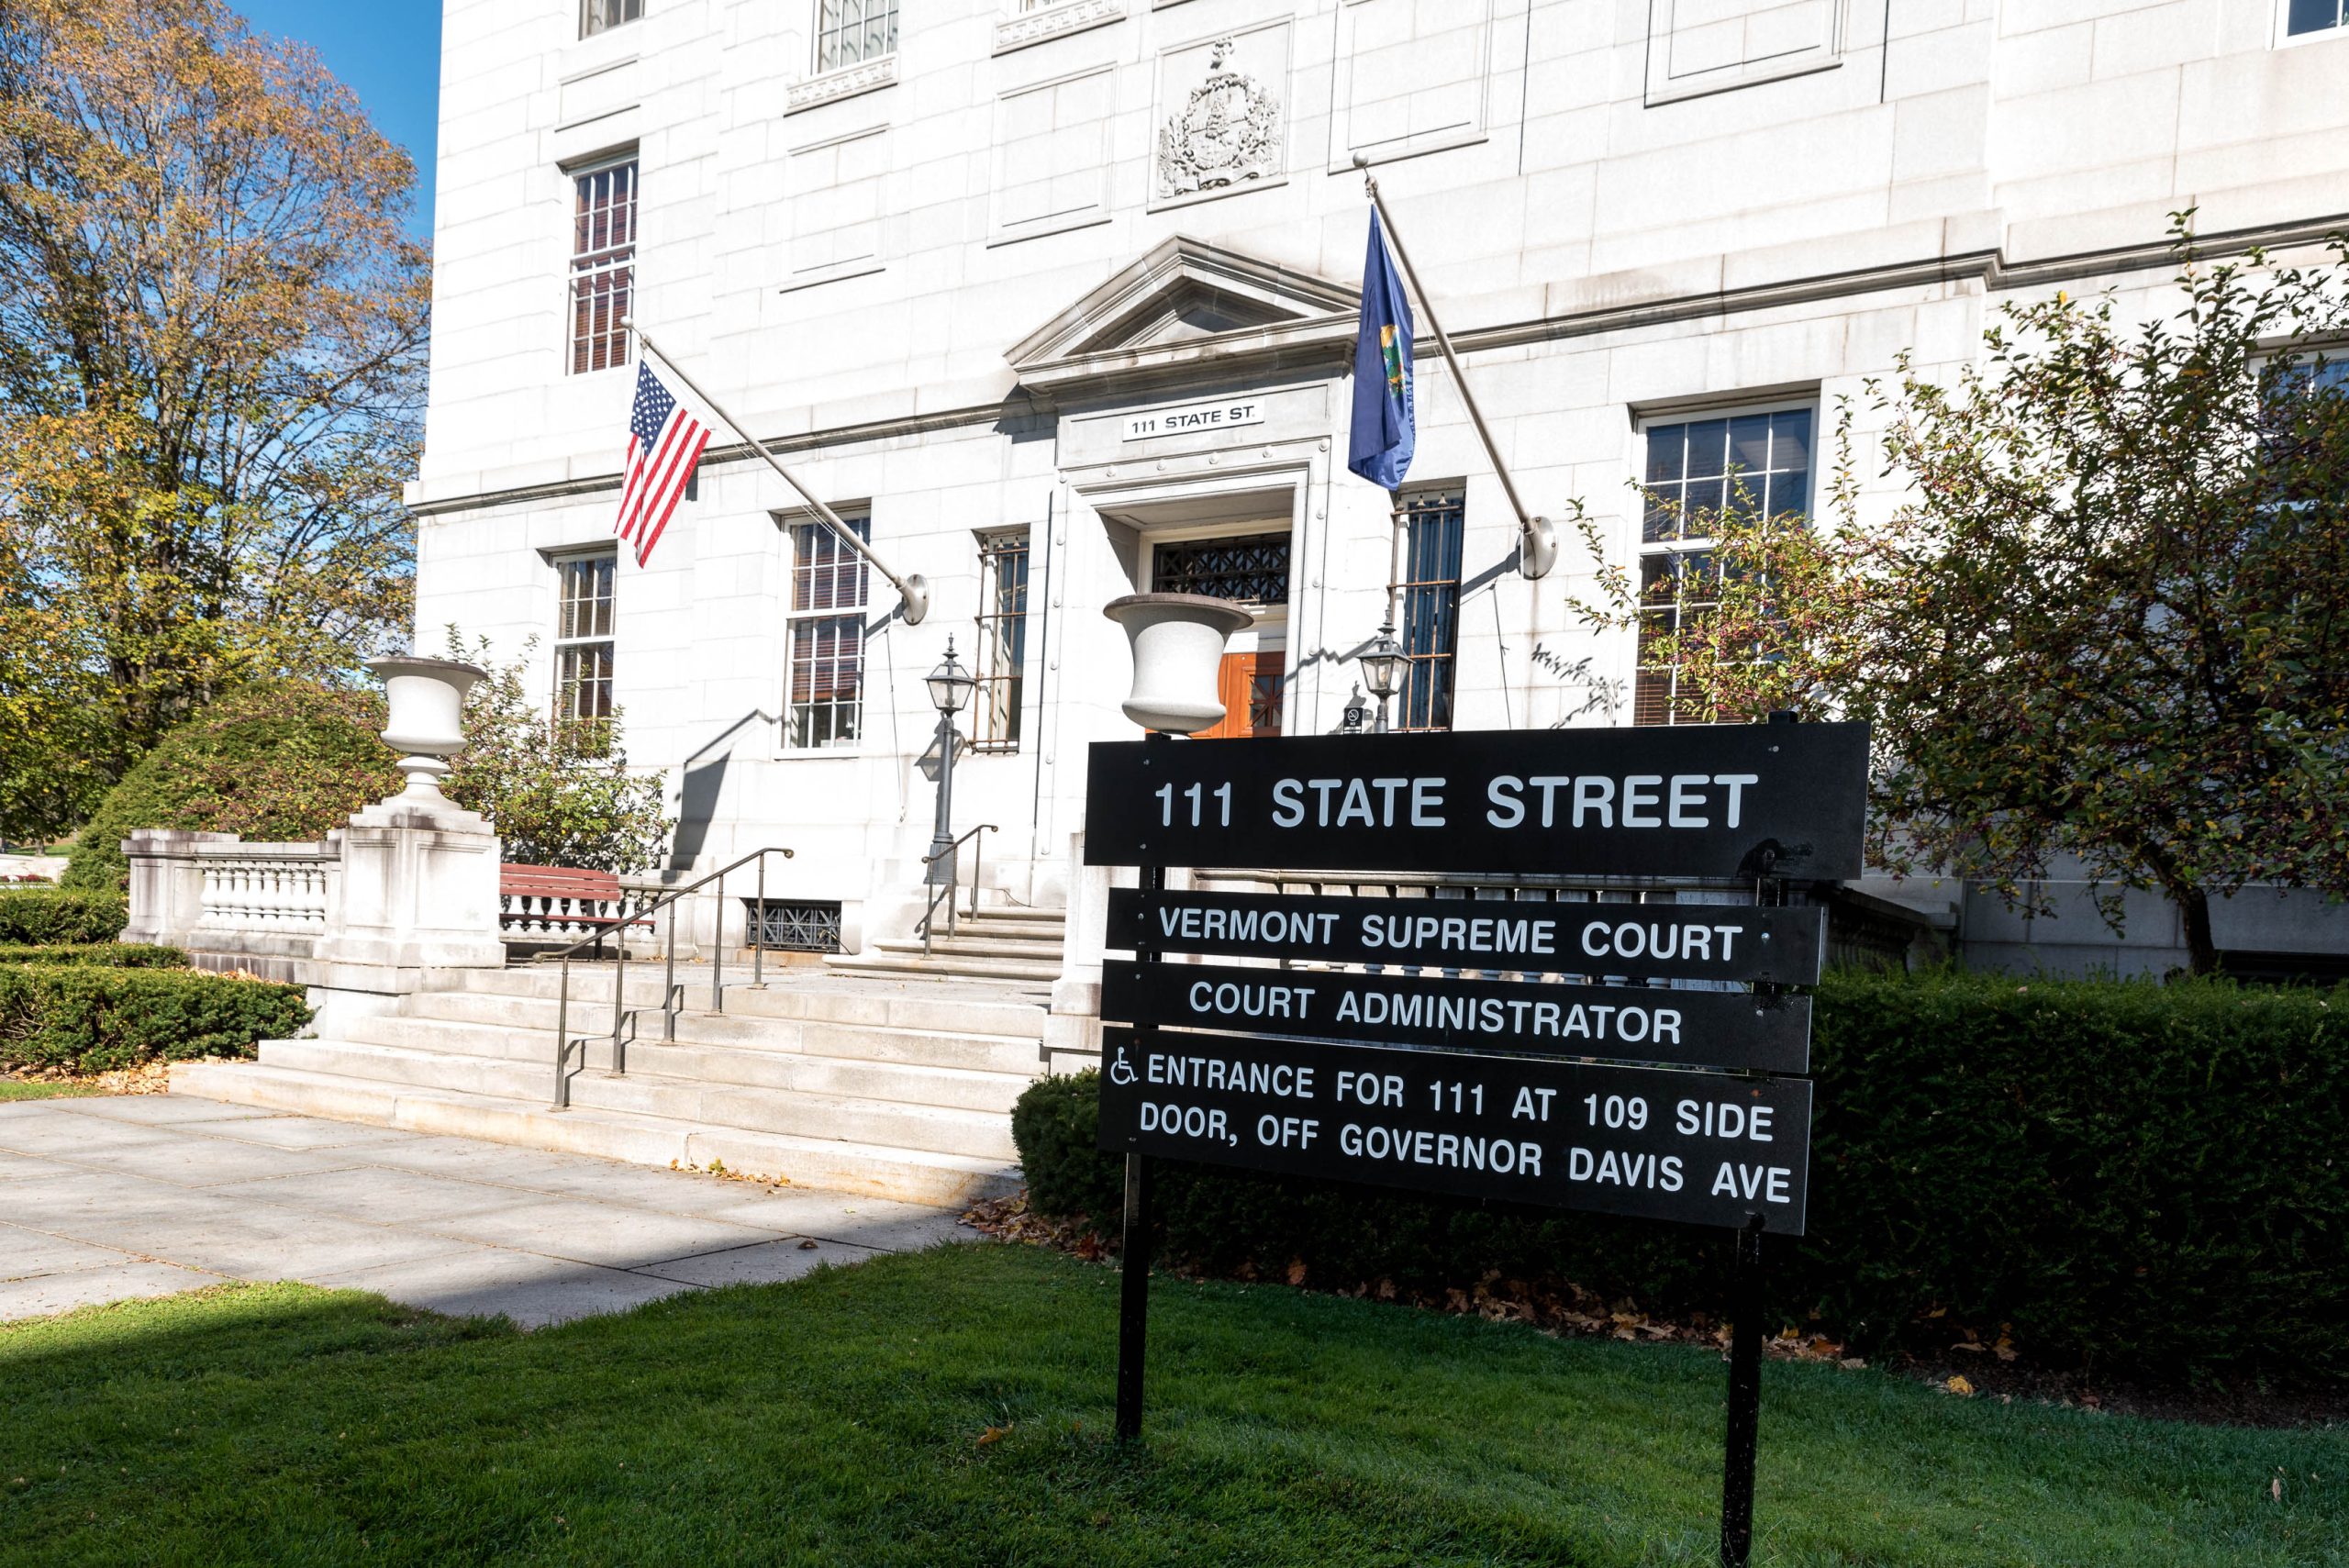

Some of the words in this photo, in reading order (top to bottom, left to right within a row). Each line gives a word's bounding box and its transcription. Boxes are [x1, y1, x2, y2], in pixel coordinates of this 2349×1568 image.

[1132, 419, 1155, 434] 111
[1165, 410, 1221, 428] STATE
[1155, 782, 1231, 828] 111
[1272, 777, 1447, 828] STATE
[1486, 773, 1759, 829] STREET
[1159, 906, 1341, 945] VERMONT
[1361, 914, 1556, 954] SUPREME
[1581, 921, 1743, 962] COURT
[1189, 981, 1316, 1019] COURT
[1336, 990, 1682, 1045] ADMINISTRATOR
[1148, 1053, 1314, 1099] ENTRANCE
[1337, 1071, 1404, 1107] FOR
[1430, 1080, 1484, 1116] 111
[1511, 1086, 1558, 1122] AT
[1584, 1093, 1648, 1130] 109
[1675, 1099, 1775, 1143] SIDE
[1140, 1102, 1238, 1148] DOOR,
[1257, 1114, 1319, 1151] OFF
[1340, 1123, 1542, 1177] GOVERNOR
[1569, 1146, 1684, 1192] DAVIS
[1710, 1162, 1792, 1204] AVE
